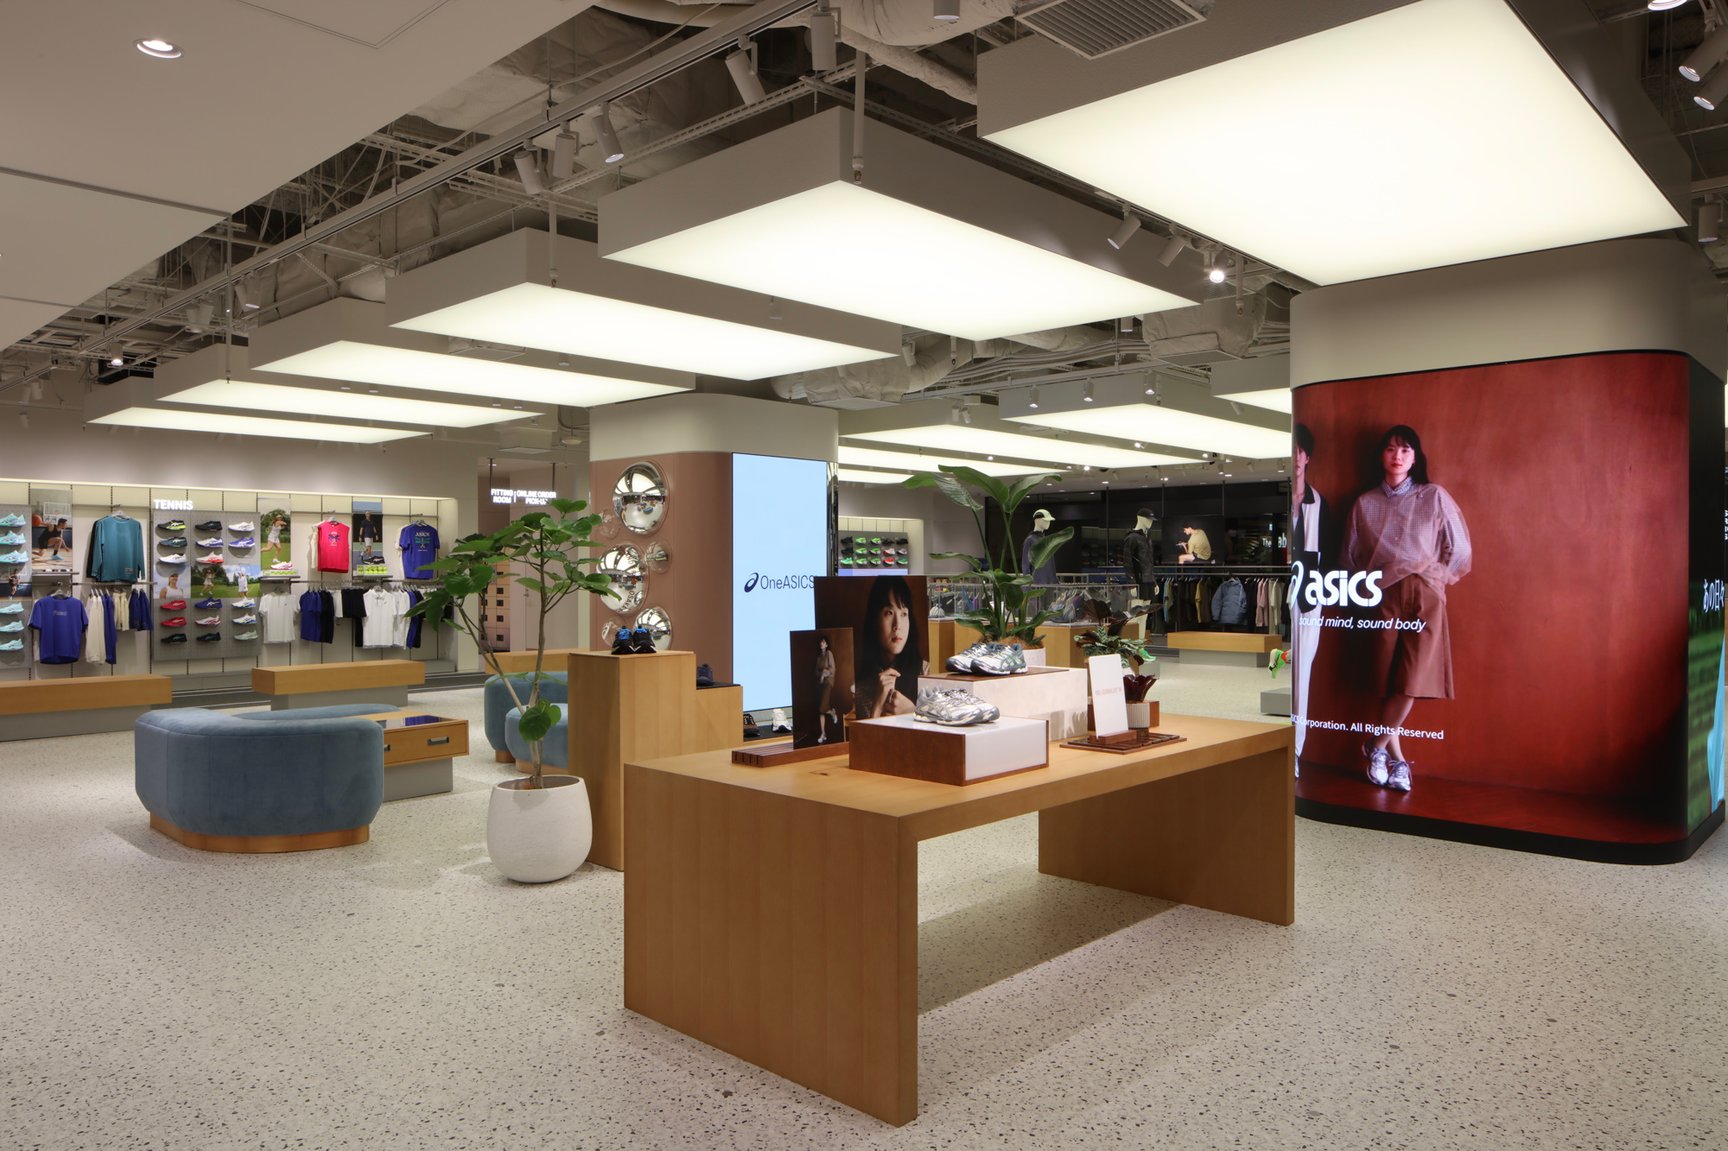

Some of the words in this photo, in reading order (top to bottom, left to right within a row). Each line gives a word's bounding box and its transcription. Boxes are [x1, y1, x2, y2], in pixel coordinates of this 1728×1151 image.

[491, 488, 513, 496] FITTING
[516, 490, 537, 498] ONLINE
[153, 499, 193, 510] TENNIS
[760, 575, 816, 589] OneASICS
[1305, 570, 1383, 607] asics
[1299, 616, 1324, 627] sound
[1325, 616, 1354, 629] mind,
[1357, 618, 1393, 629] sound
[1395, 618, 1427, 633] body
[1350, 723, 1363, 732] All
[1365, 723, 1396, 737] Rights
[1398, 727, 1444, 740] Reserved
